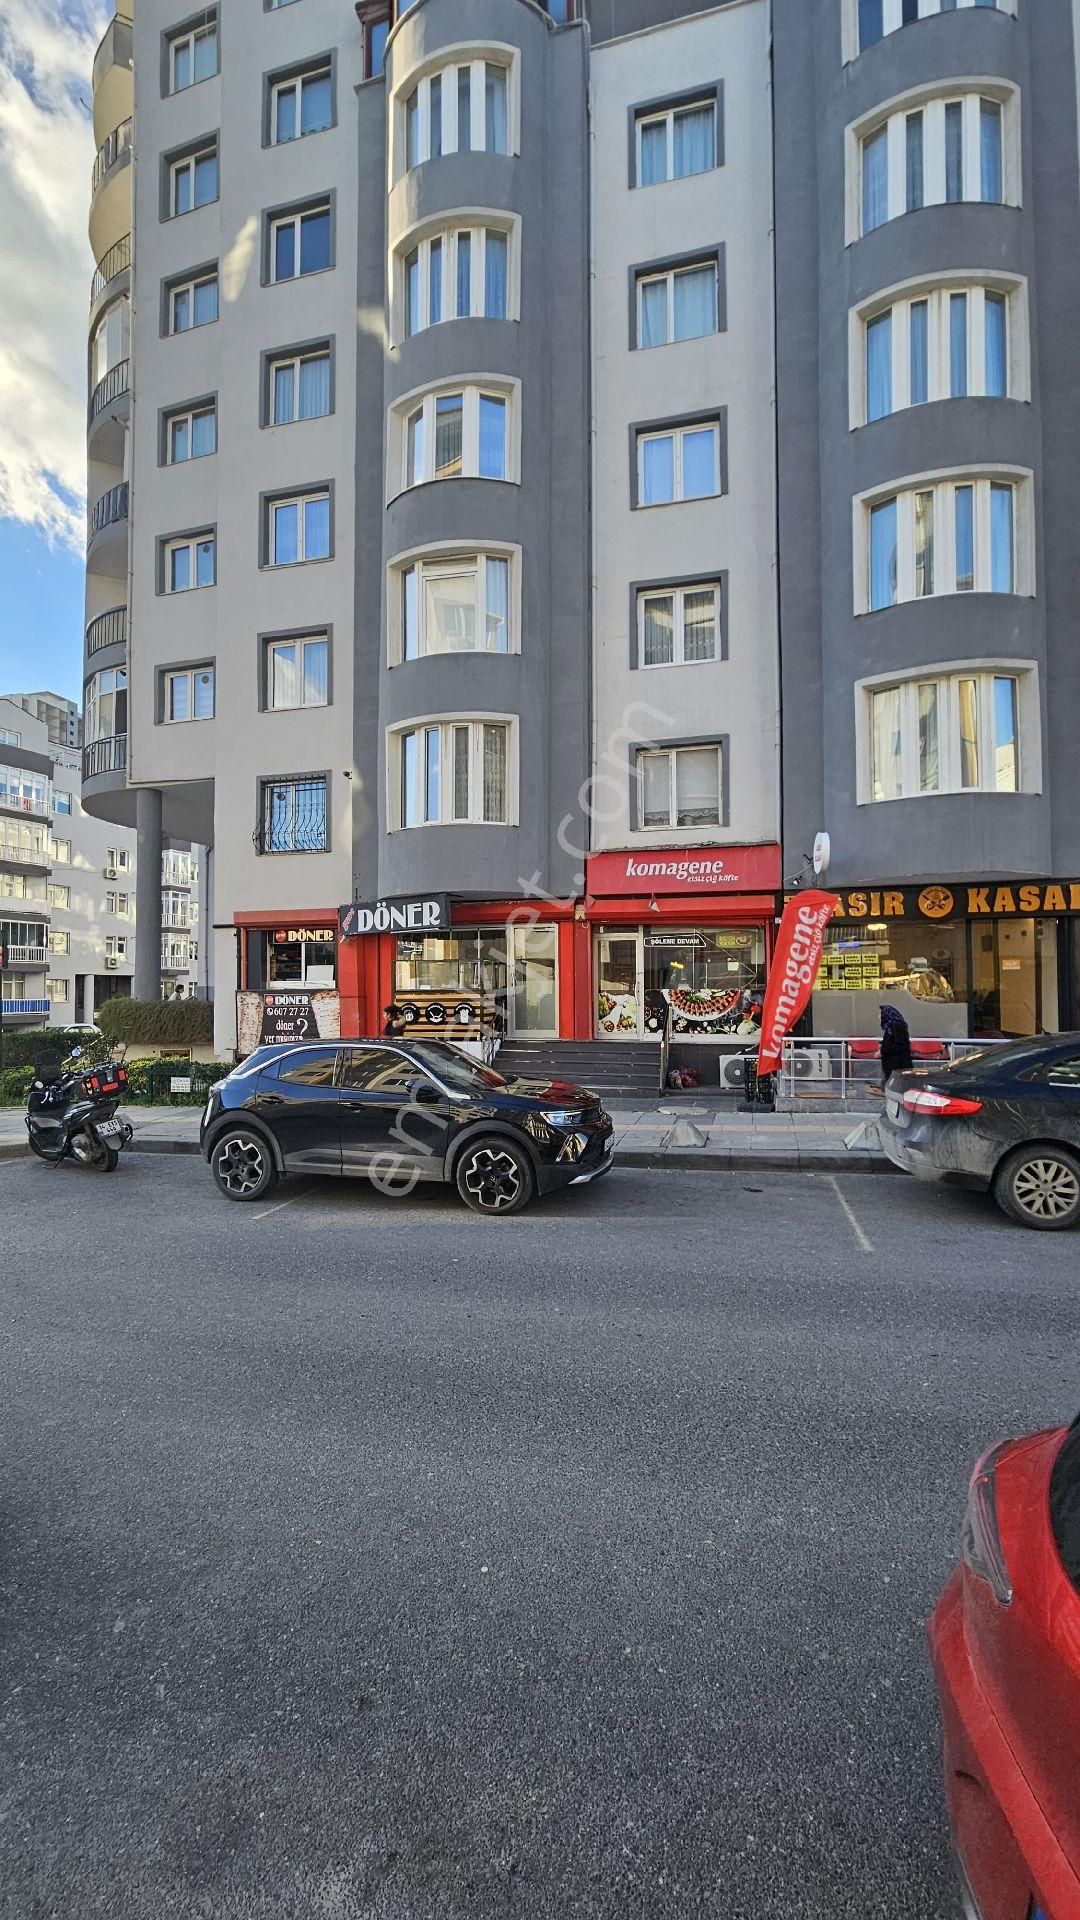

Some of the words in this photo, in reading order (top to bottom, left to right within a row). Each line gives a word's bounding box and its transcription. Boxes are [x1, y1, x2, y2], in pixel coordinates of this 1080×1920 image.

[626, 858, 724, 880] komagene
[687, 875, 705, 883] etsiz
[705, 874, 717, 884] çiğ
[718, 873, 740, 882] köfte
[357, 901, 441, 932] DÖNER
[287, 928, 334, 942] DÖNER
[677, 937, 700, 945] DEVAM
[761, 906, 819, 1060] komagene
[275, 994, 309, 1005] DÖNER
[274, 1007, 287, 1016] 607
[289, 1007, 298, 1016] 27
[299, 1007, 309, 1016] 27
